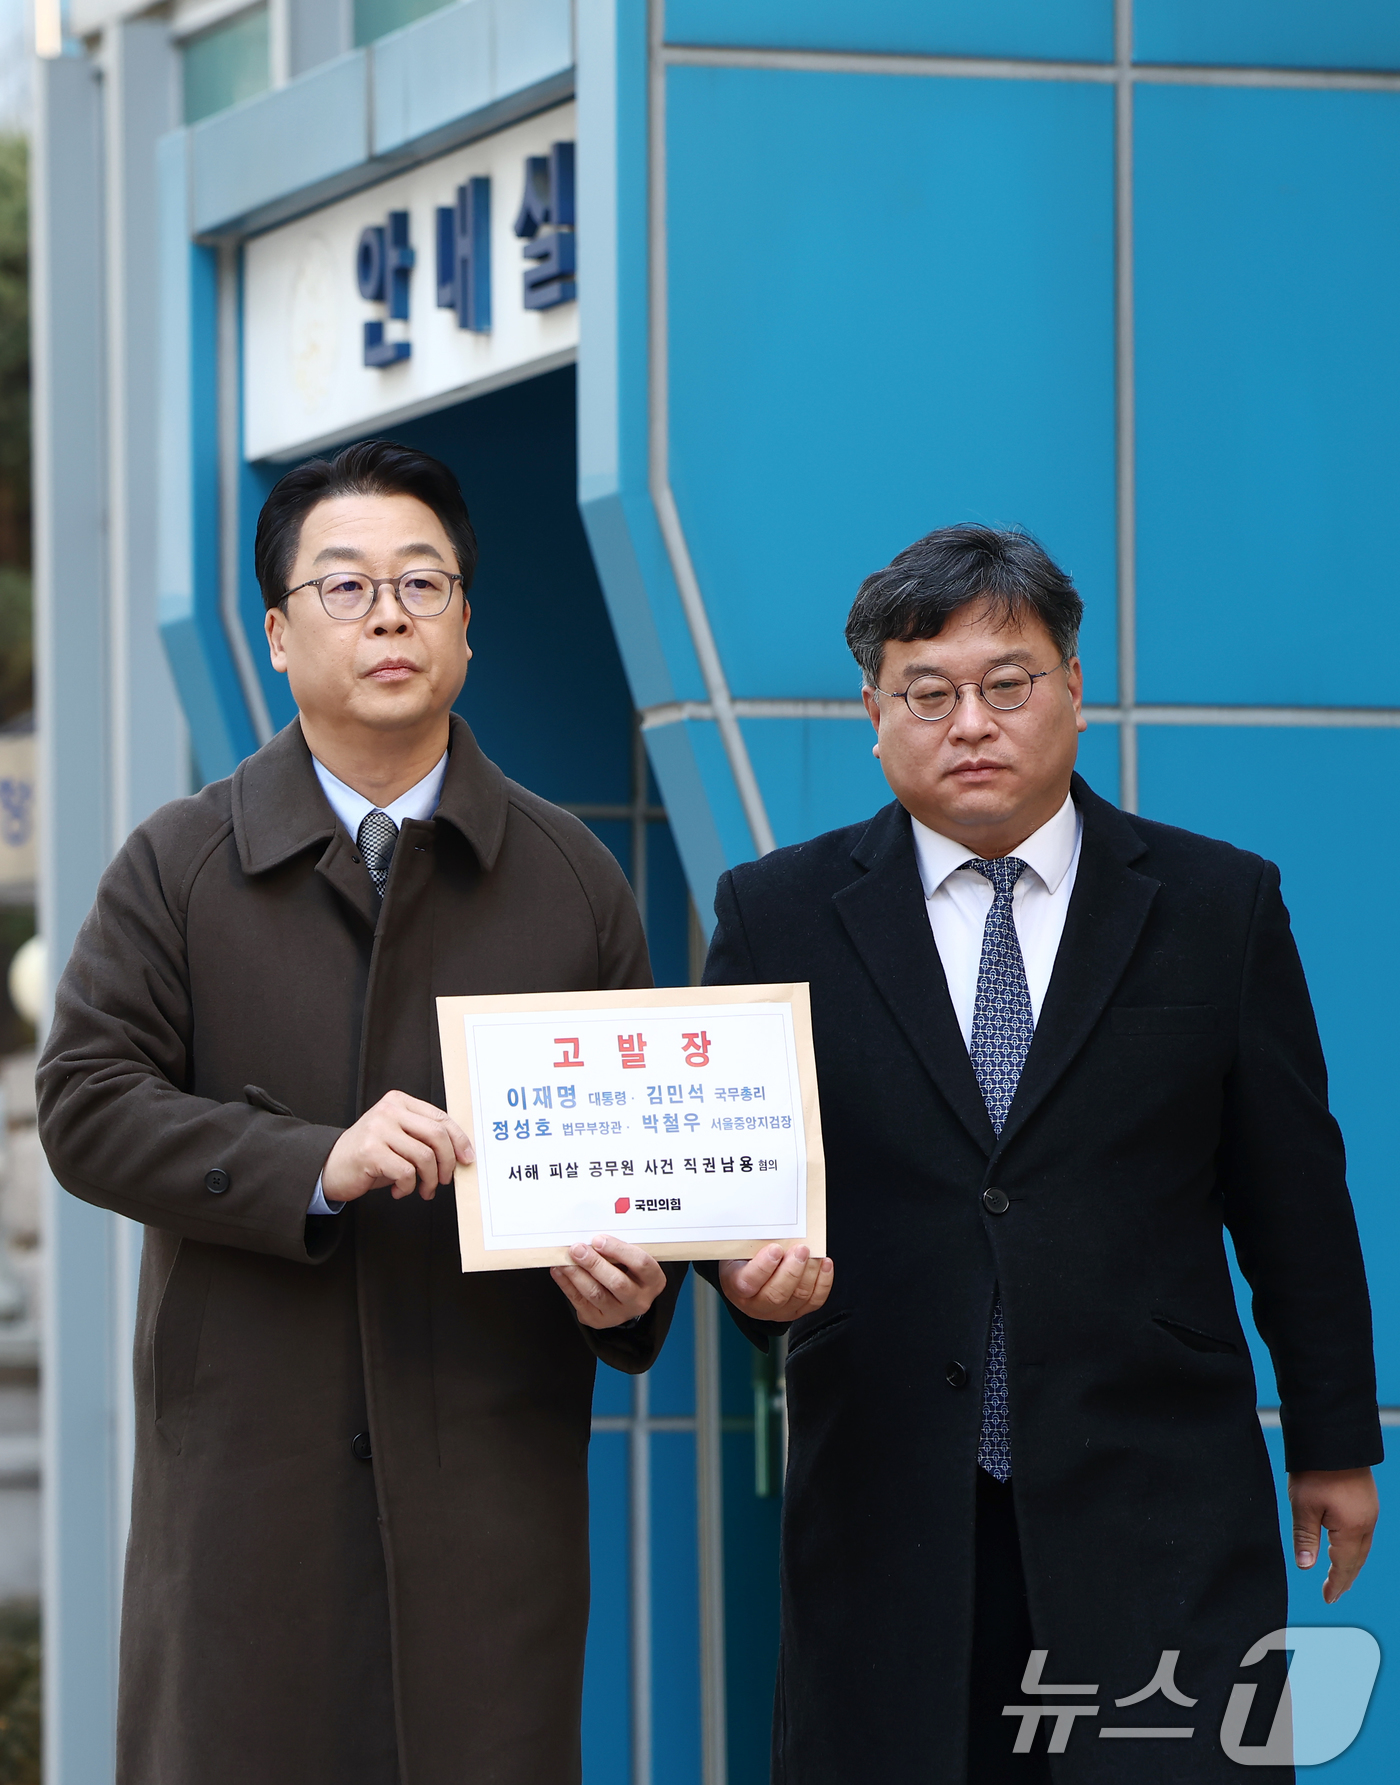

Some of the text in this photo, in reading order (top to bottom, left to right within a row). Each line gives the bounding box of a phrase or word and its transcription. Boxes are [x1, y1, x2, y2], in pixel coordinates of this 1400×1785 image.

[356, 140, 576, 368] 안내실
[507, 1084, 577, 1111] 이재명
[646, 1084, 705, 1105] 김민석
[714, 1086, 766, 1103] 국무총리
[492, 1118, 553, 1141] 정성호
[642, 1112, 701, 1135] 박철우
[710, 1115, 792, 1132] 서울중앙지검장
[508, 1164, 540, 1182] 서해
[549, 1161, 579, 1179] 피살
[588, 1159, 635, 1178] 공무원
[644, 1157, 675, 1176] 사건
[683, 1155, 754, 1175] 직권남용
[634, 1197, 682, 1213] 국민의힘
